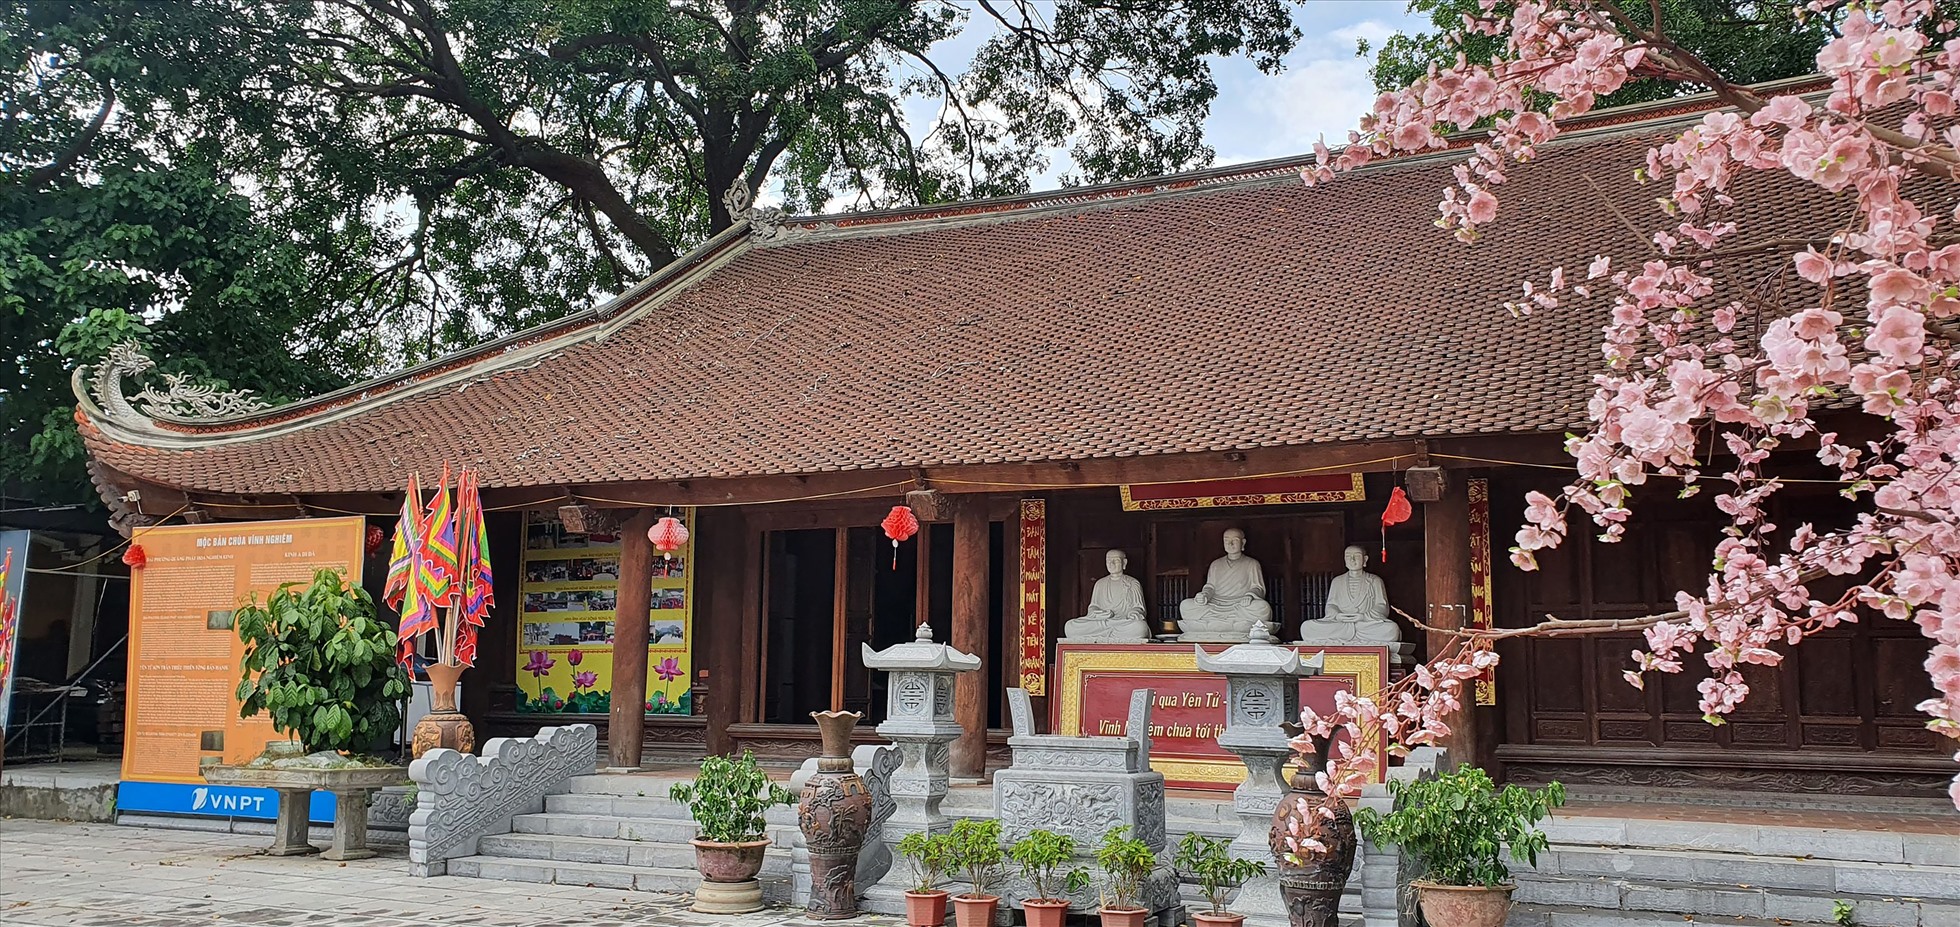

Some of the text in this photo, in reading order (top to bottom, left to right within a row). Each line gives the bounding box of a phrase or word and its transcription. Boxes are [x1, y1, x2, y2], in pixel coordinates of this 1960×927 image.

[196, 532, 293, 549] MỘC BẢN CHÙA VĨNH NGHIÊM
[1159, 695, 1178, 709] qua
[1182, 692, 1202, 707] Yên
[1206, 691, 1221, 708] Tử
[1099, 719, 1121, 735] Vĩnh
[1166, 722, 1192, 738] chưa
[1195, 722, 1211, 739] tới
[210, 794, 265, 811] VNPT
